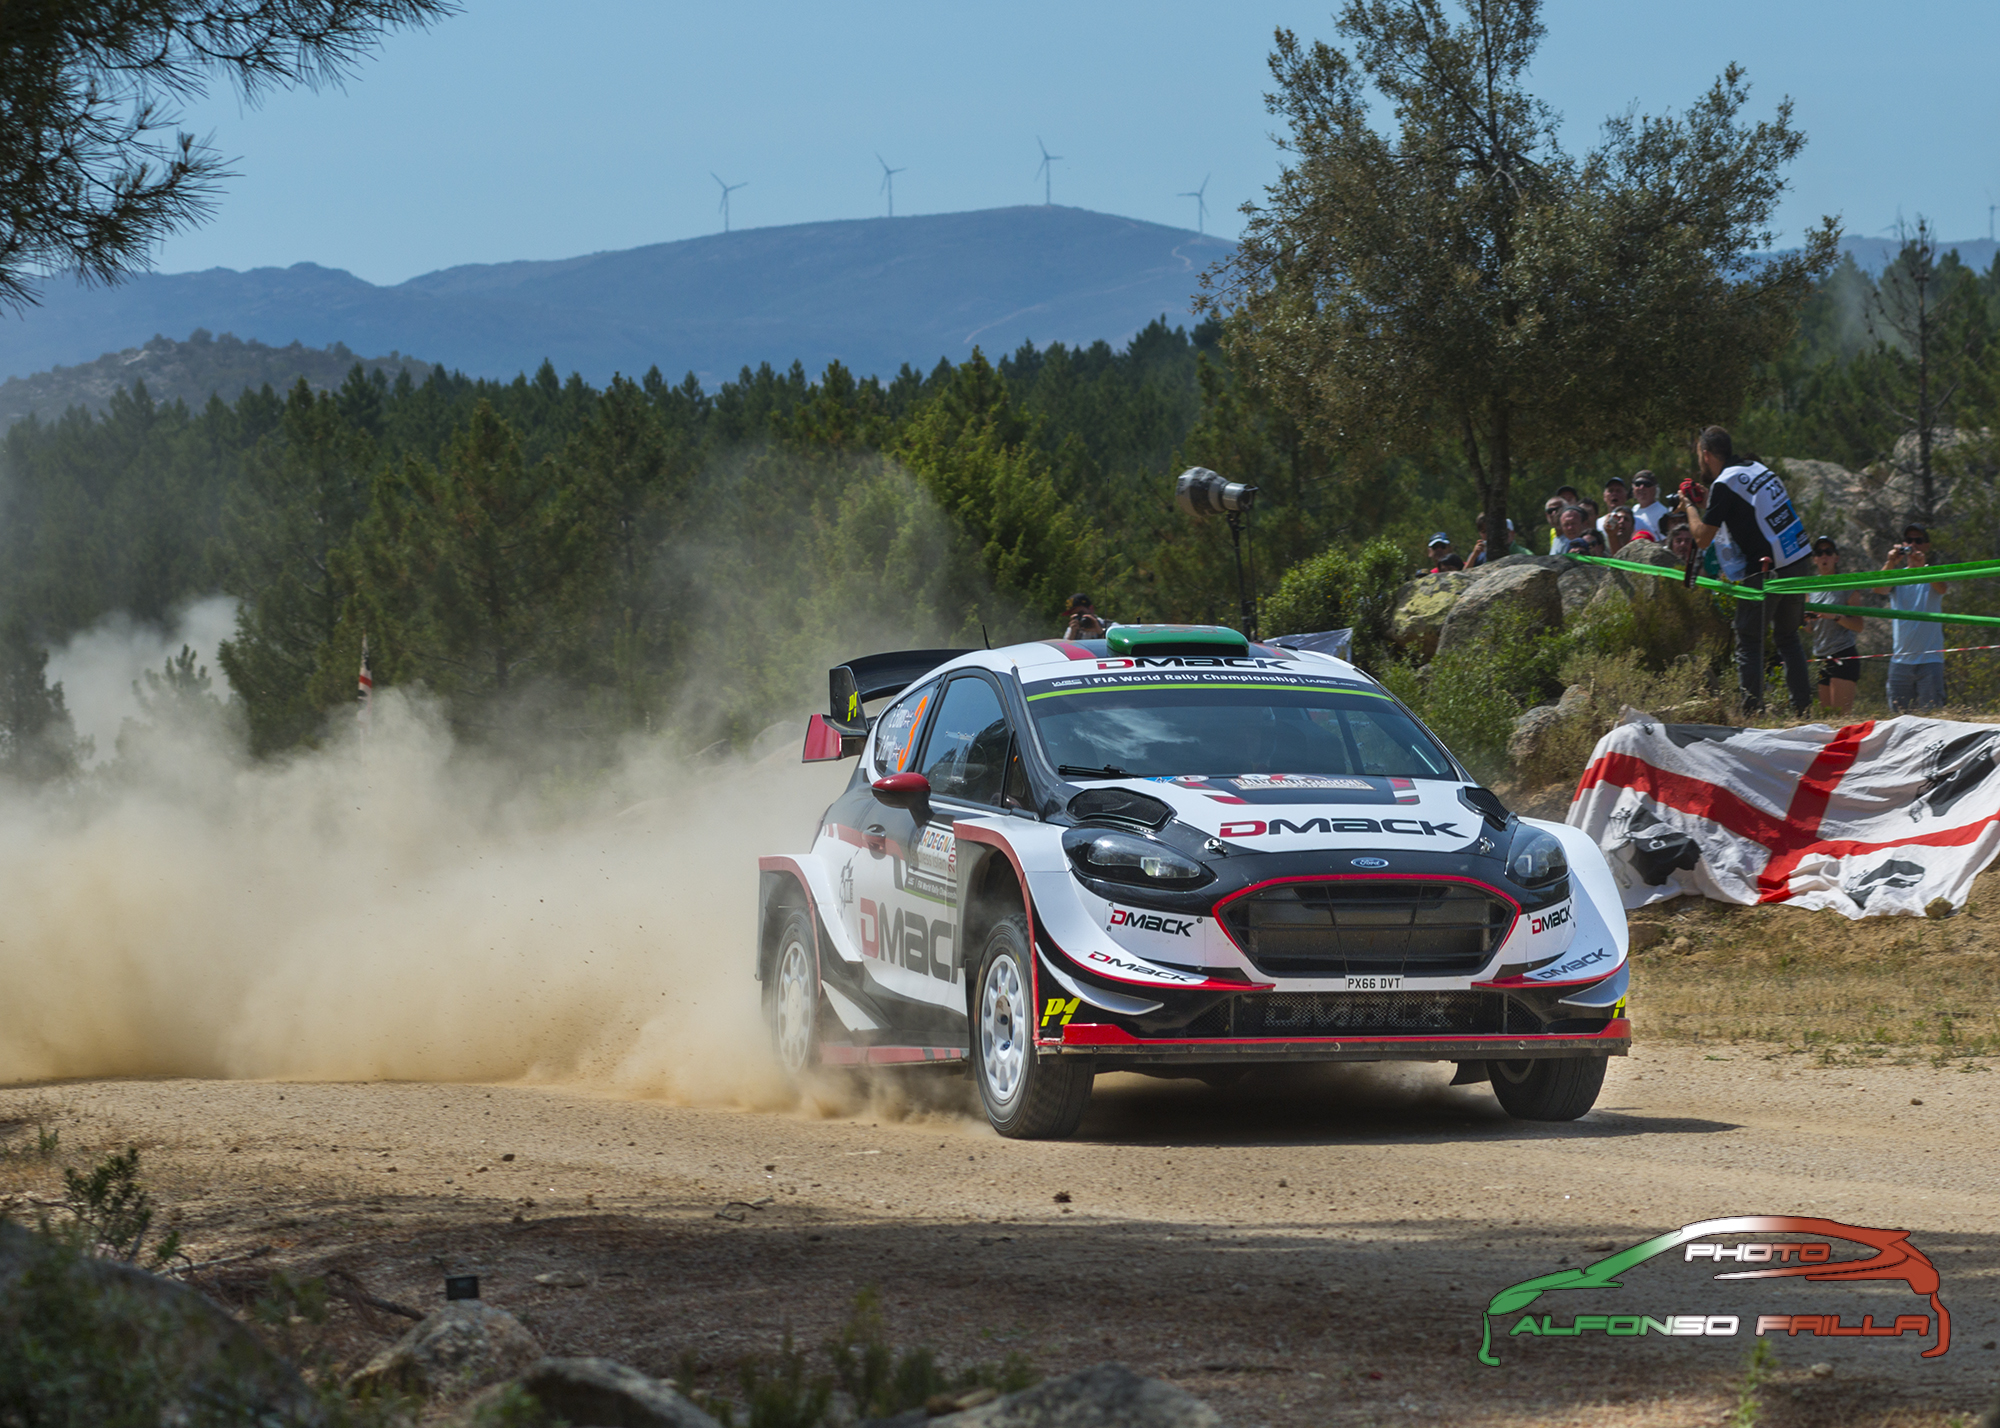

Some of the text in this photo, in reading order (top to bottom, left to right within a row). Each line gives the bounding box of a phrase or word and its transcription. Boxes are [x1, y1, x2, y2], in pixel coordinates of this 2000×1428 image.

[1093, 676, 1118, 684] FIA
[1119, 674, 1161, 682] World
[1164, 674, 1198, 682] Rally
[1202, 673, 1298, 684] Championship
[846, 691, 858, 722] P1
[897, 695, 928, 772] 3
[1347, 977, 1401, 989] PX66 DVT
[1041, 997, 1081, 1027] P1
